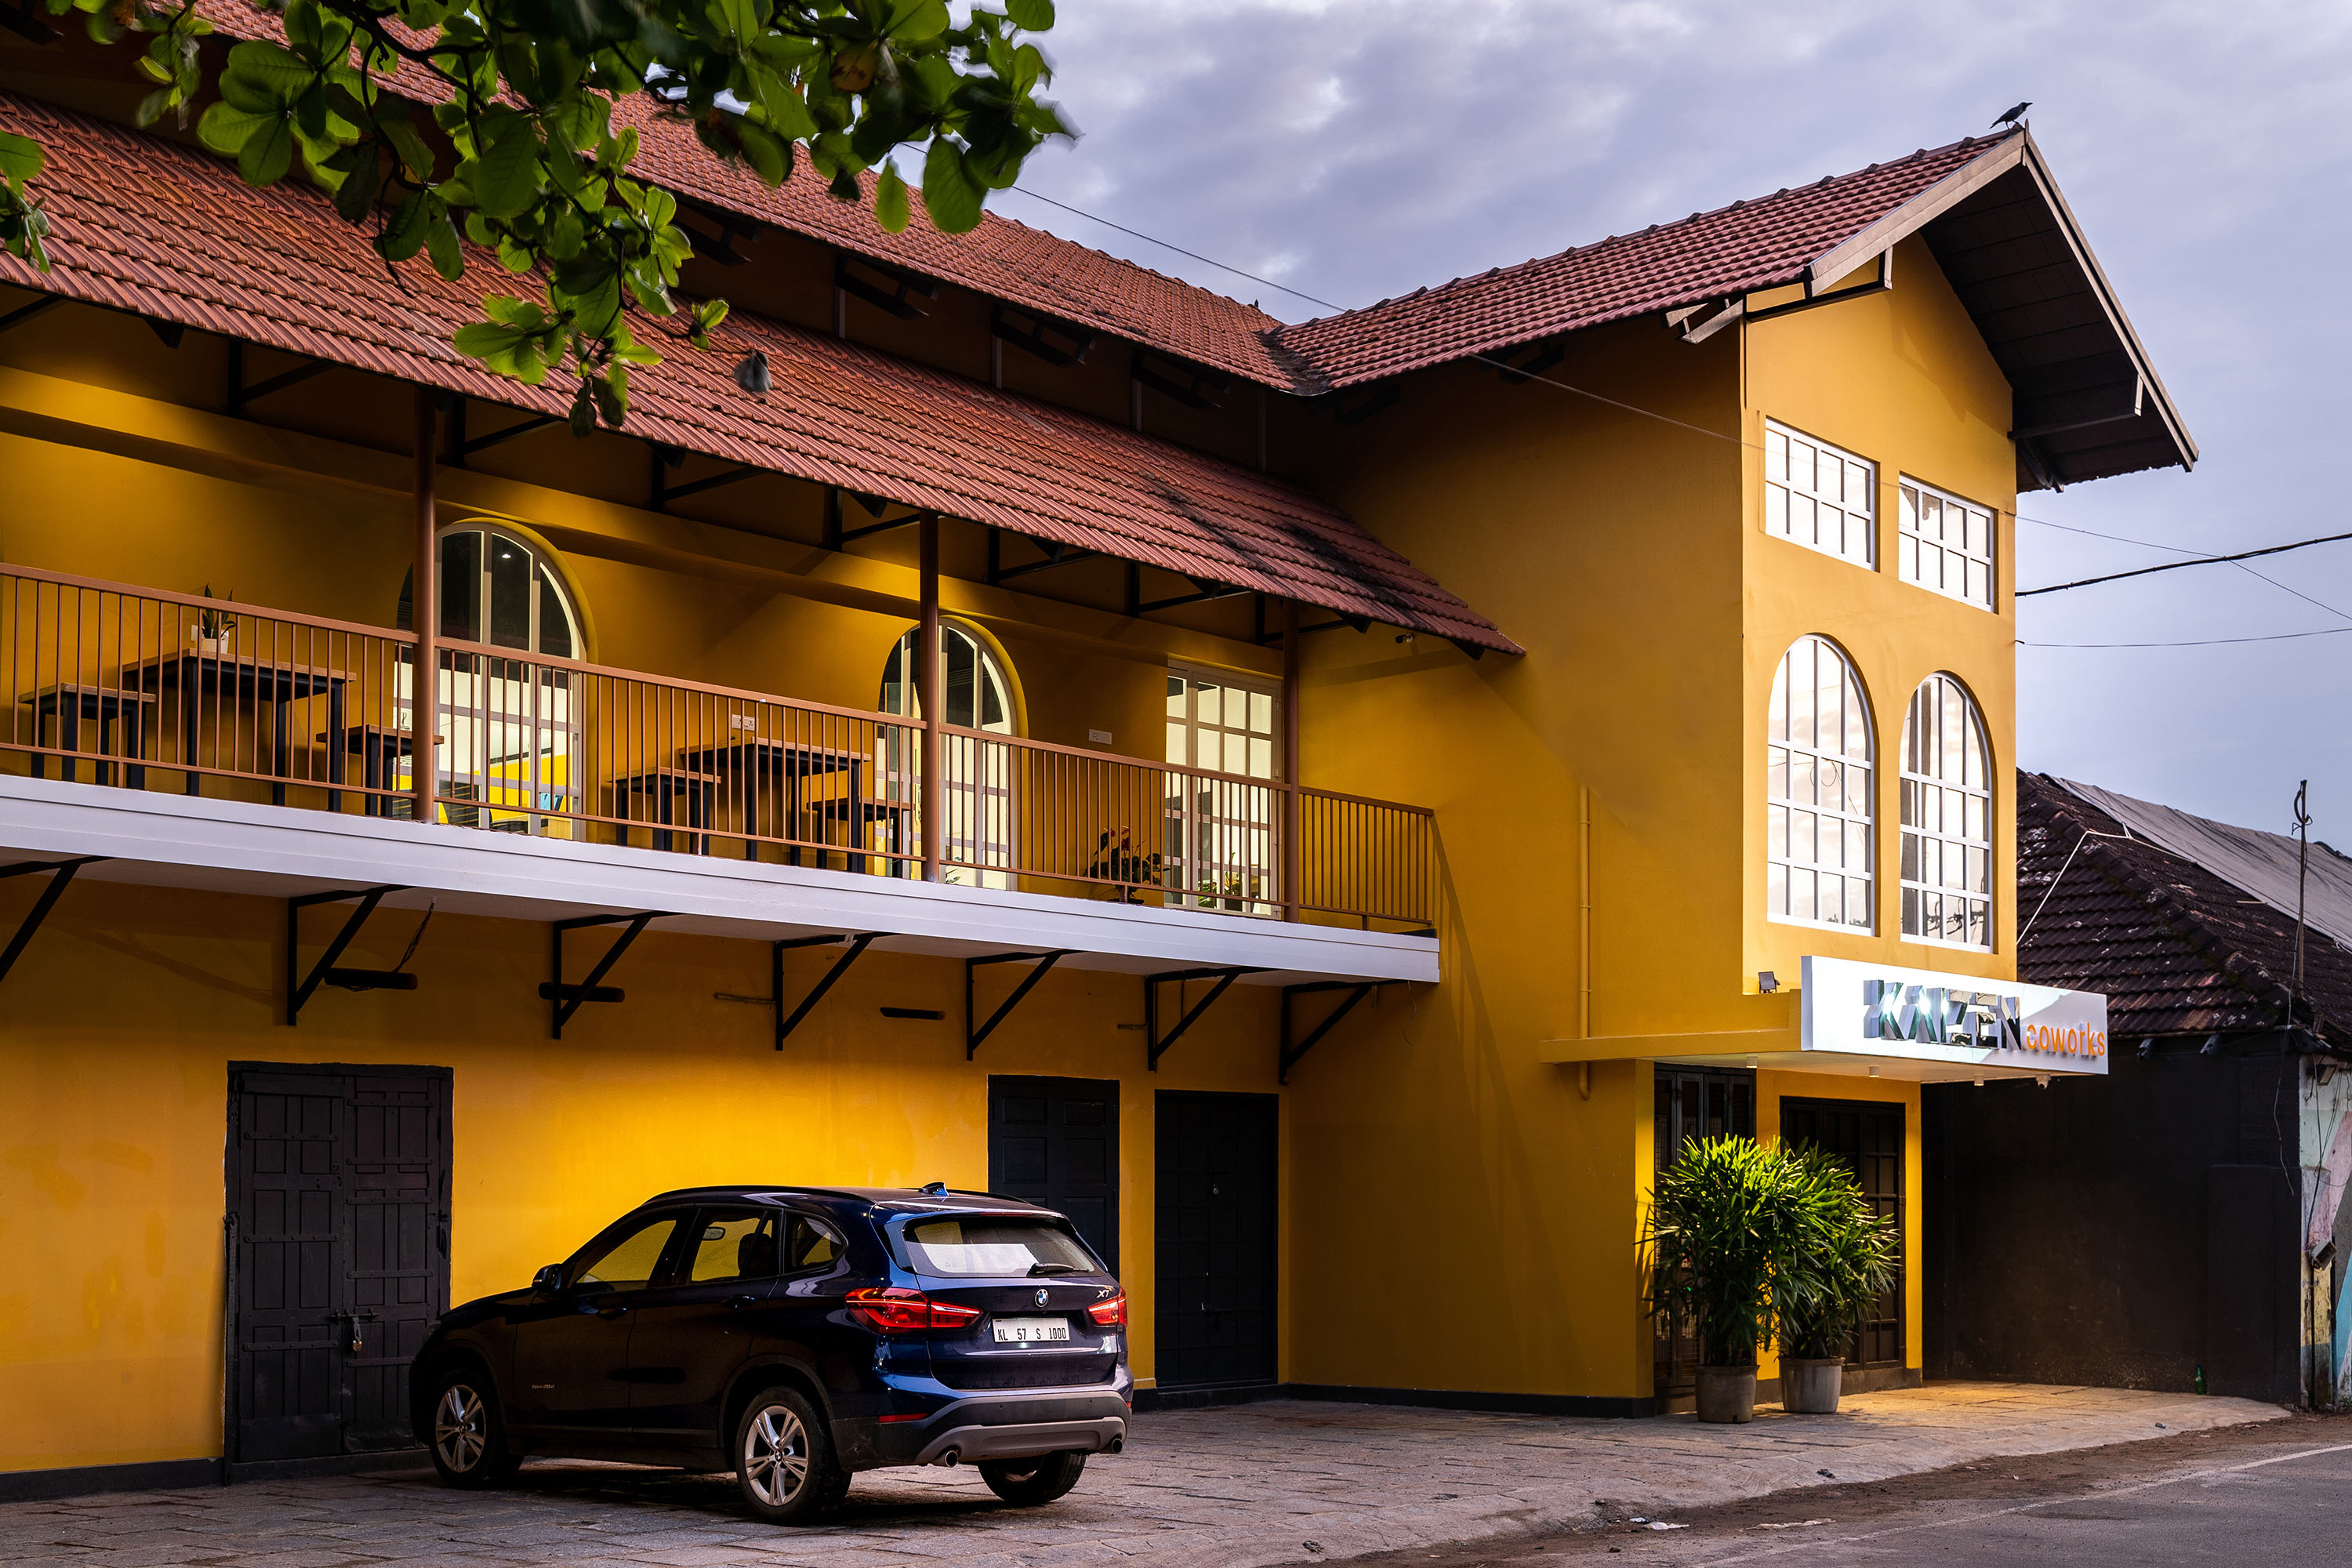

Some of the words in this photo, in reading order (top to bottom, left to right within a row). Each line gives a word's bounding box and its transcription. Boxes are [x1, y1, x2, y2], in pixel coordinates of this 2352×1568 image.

[1864, 979, 2021, 1050] KAIZEN
[2026, 1022, 2105, 1056] coworks
[1096, 1290, 1110, 1298] X1
[997, 1329, 1008, 1341] KL
[1017, 1328, 1026, 1340] 57
[1036, 1328, 1041, 1340] S
[1049, 1327, 1066, 1339] 1000
